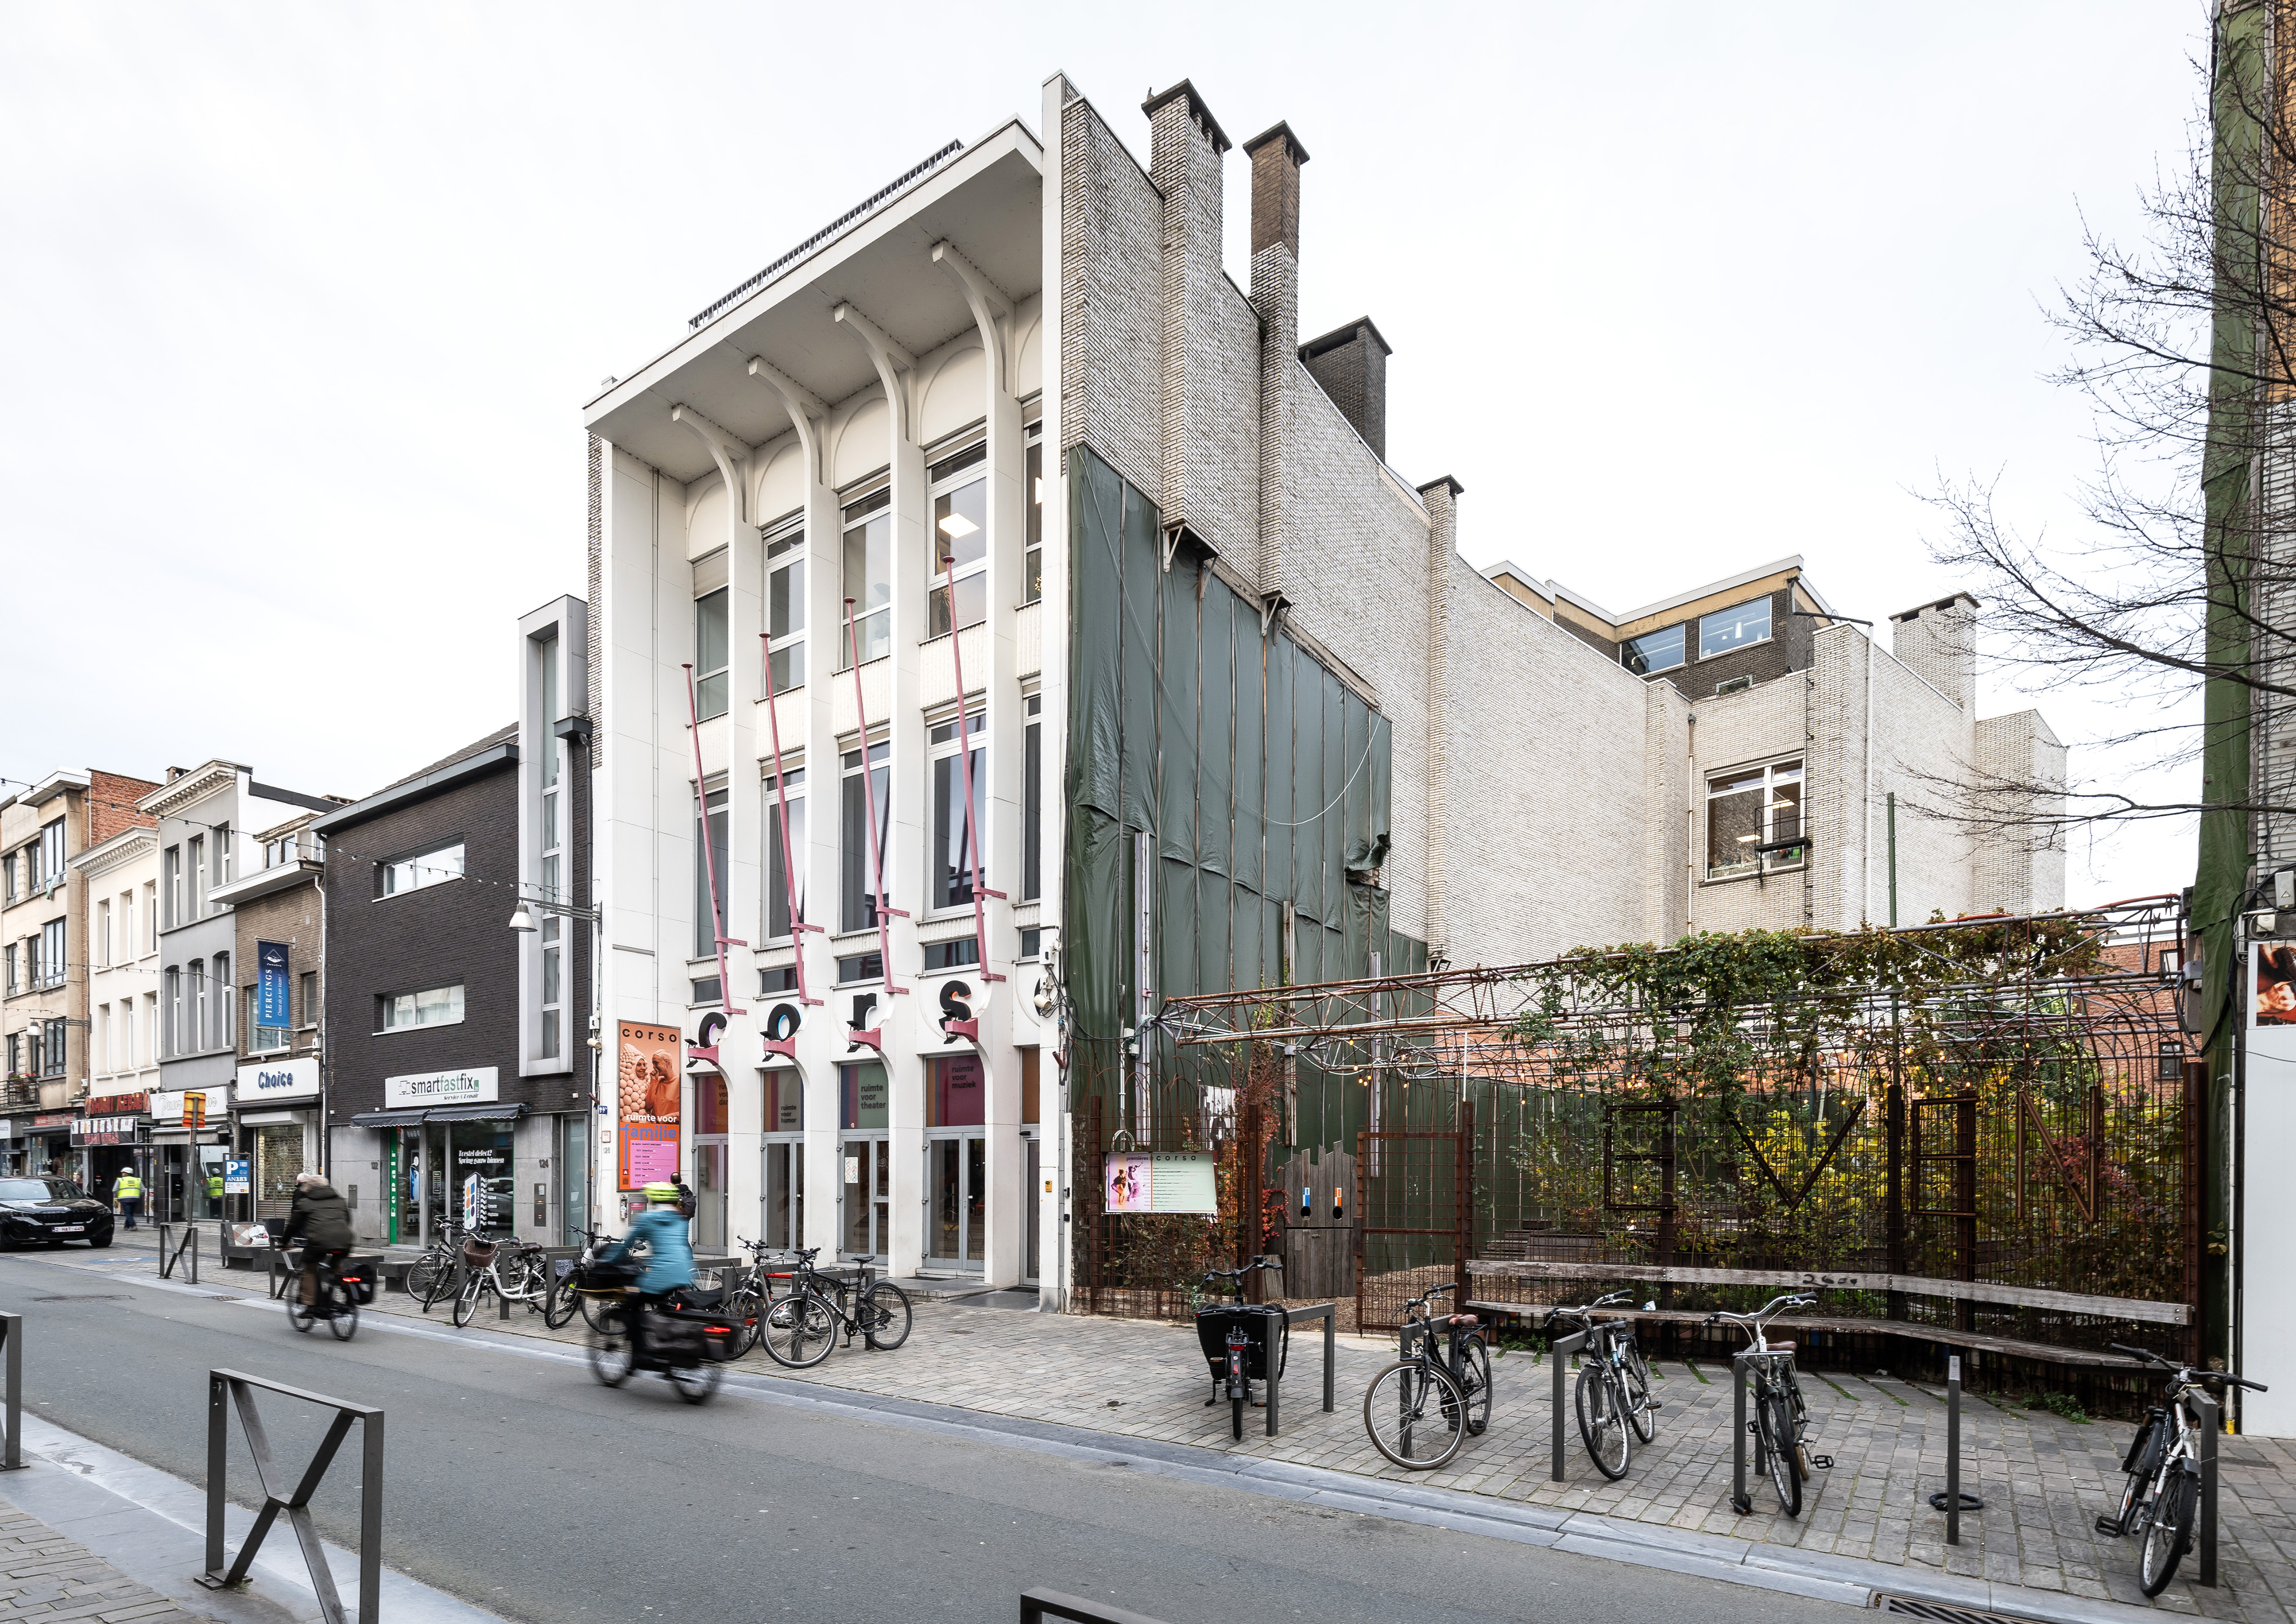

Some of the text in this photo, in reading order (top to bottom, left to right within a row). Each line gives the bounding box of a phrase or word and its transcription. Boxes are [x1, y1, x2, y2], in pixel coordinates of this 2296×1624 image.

[622, 1029, 677, 1042] corso
[258, 1071, 293, 1089] Choice
[952, 1080, 976, 1089] muziek
[861, 1084, 883, 1092] ruimte
[861, 1101, 886, 1109] theater
[626, 1112, 656, 1122] ruimte
[226, 1161, 239, 1175] P
[539, 1159, 549, 1168] 124
